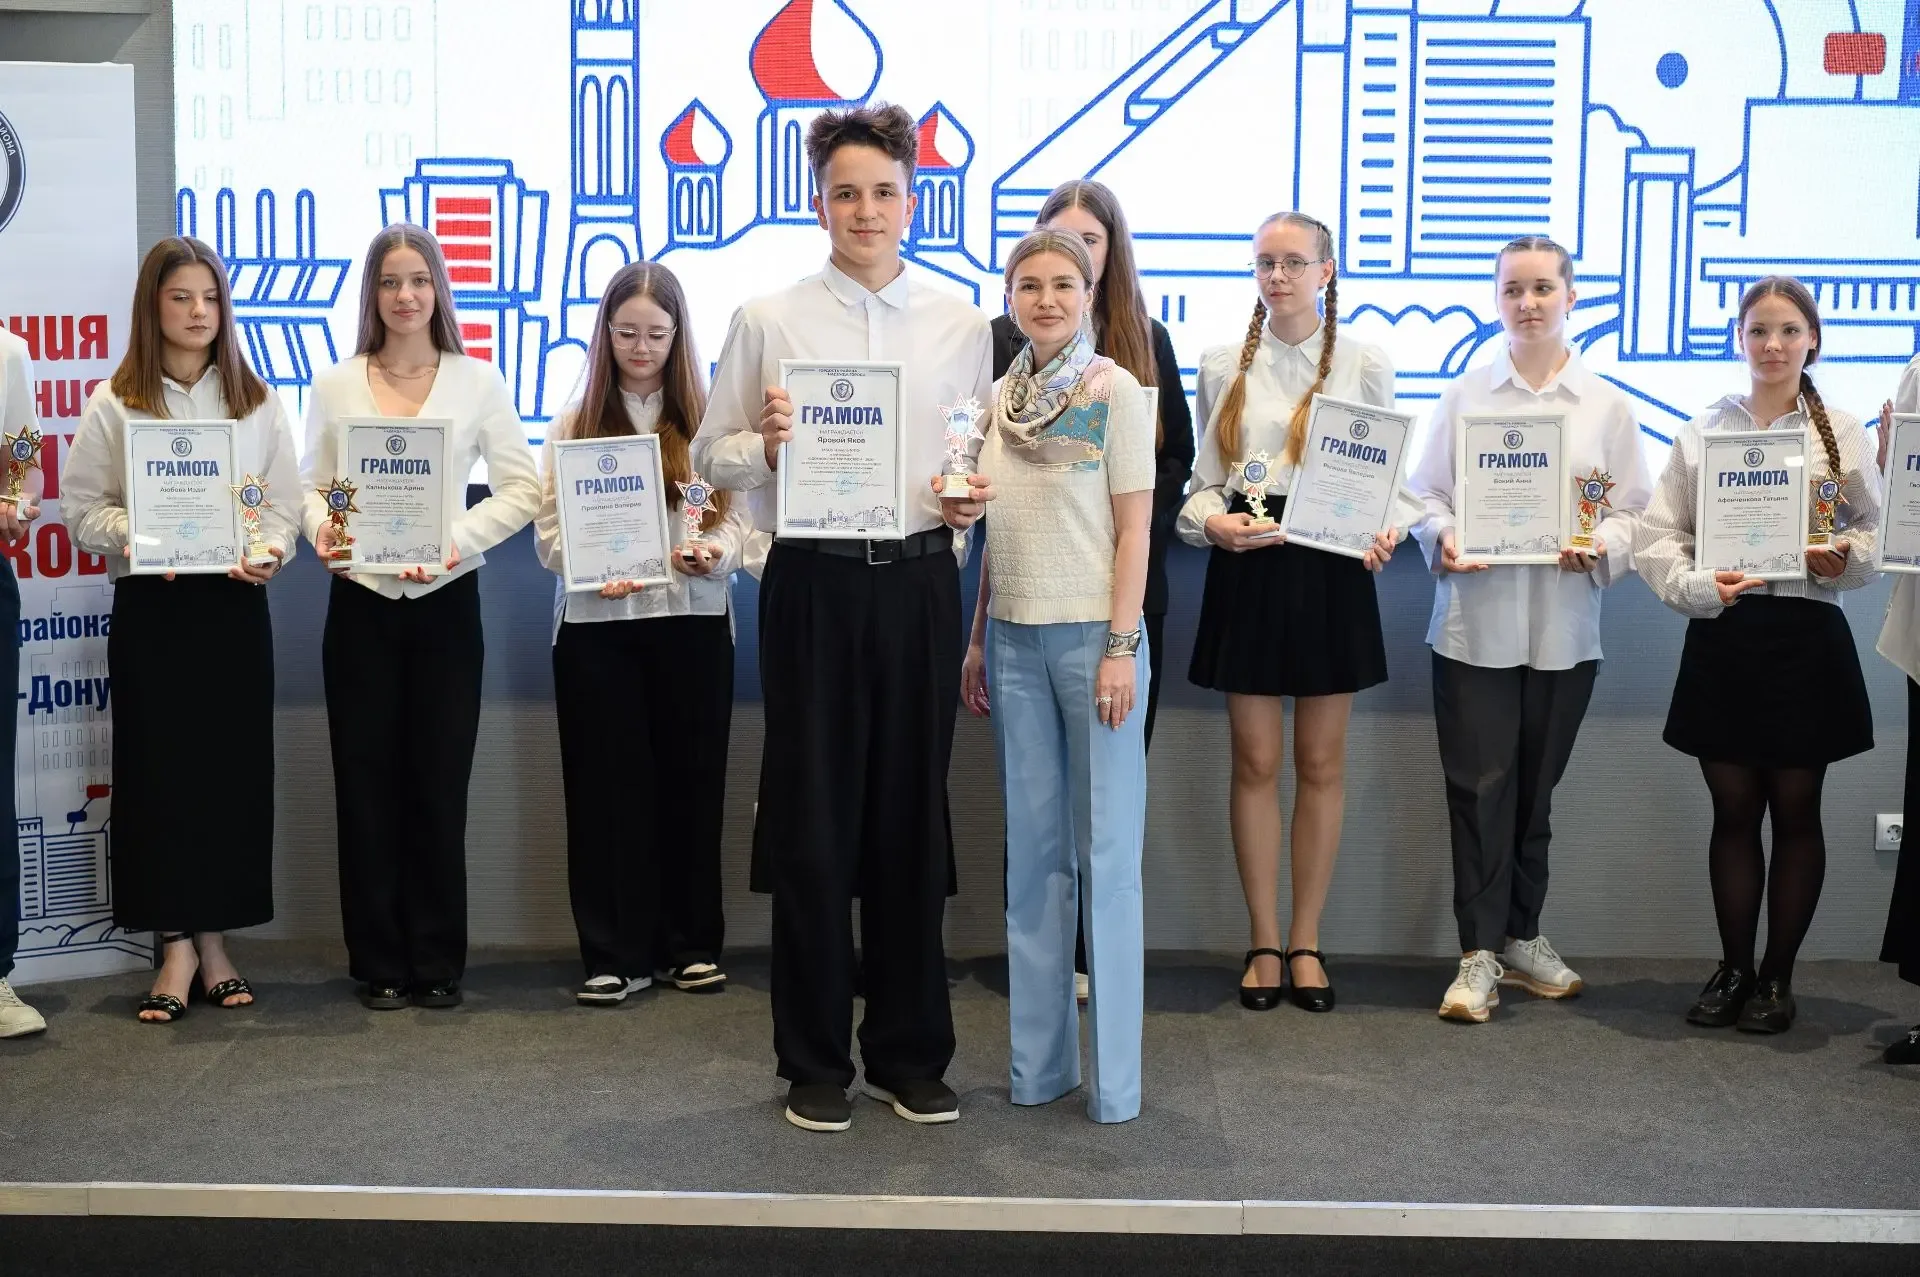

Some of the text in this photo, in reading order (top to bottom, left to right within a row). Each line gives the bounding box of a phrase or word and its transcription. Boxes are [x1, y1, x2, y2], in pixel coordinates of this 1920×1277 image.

[0, 315, 108, 361] ния
[801, 405, 883, 425] ГРАМОТА
[1320, 436, 1387, 466] ГРАМОТА
[146, 460, 220, 477] ГРАМОТА
[361, 458, 431, 475] ГРАМОТА
[1479, 453, 1548, 469] ГРАМОТА
[575, 475, 645, 496] ГРАМОТА
[1718, 470, 1789, 488] ГРАМОТА
